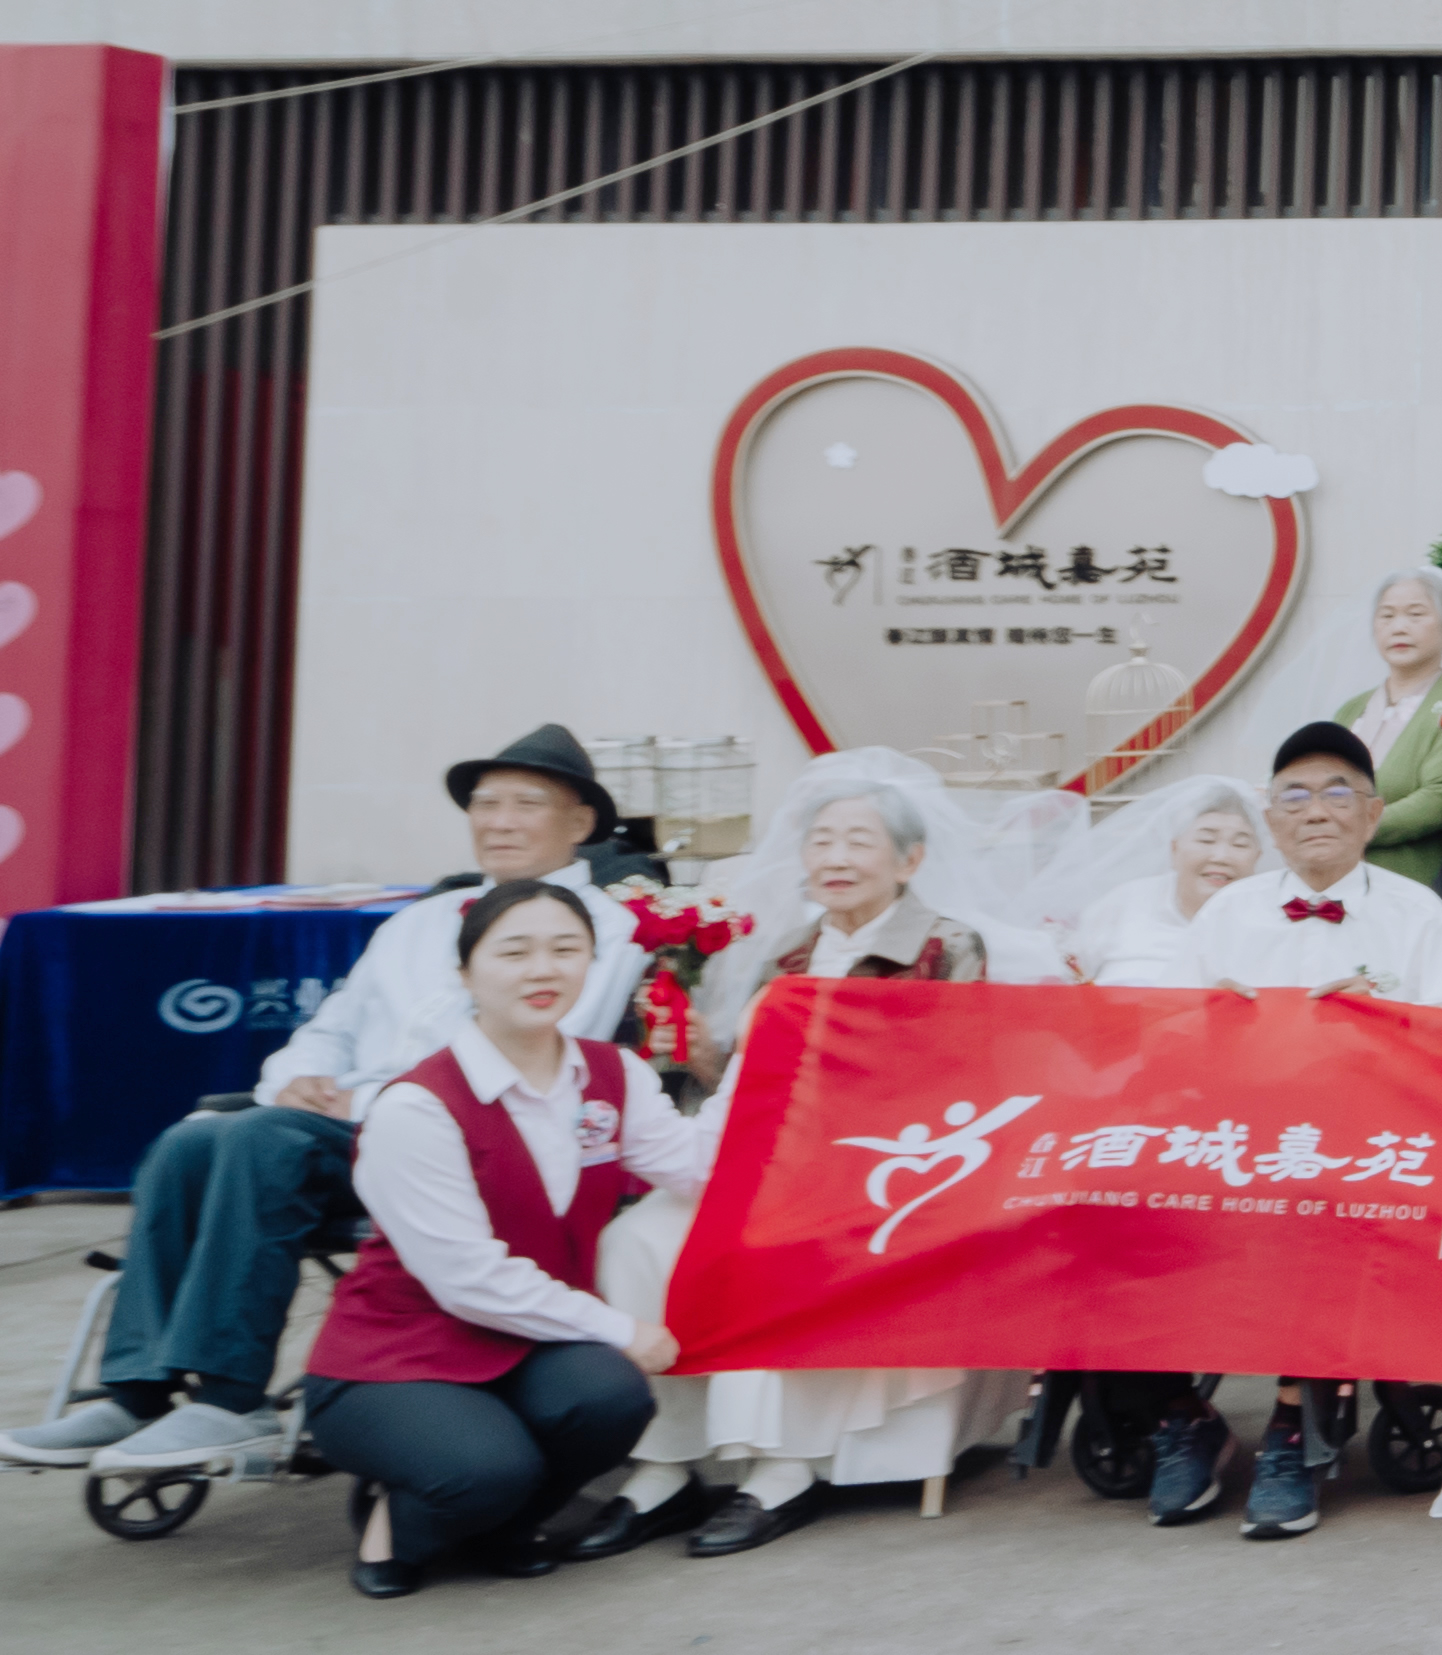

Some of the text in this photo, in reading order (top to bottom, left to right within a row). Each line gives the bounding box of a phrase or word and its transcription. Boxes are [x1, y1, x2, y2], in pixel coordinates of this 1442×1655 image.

[1058, 1119, 1436, 1188] 酒城嘉苑
[1147, 1192, 1213, 1212] CARE
[1221, 1196, 1290, 1216] HOME
[1297, 1199, 1328, 1216] OF
[1336, 1201, 1428, 1221] LUZHOU
